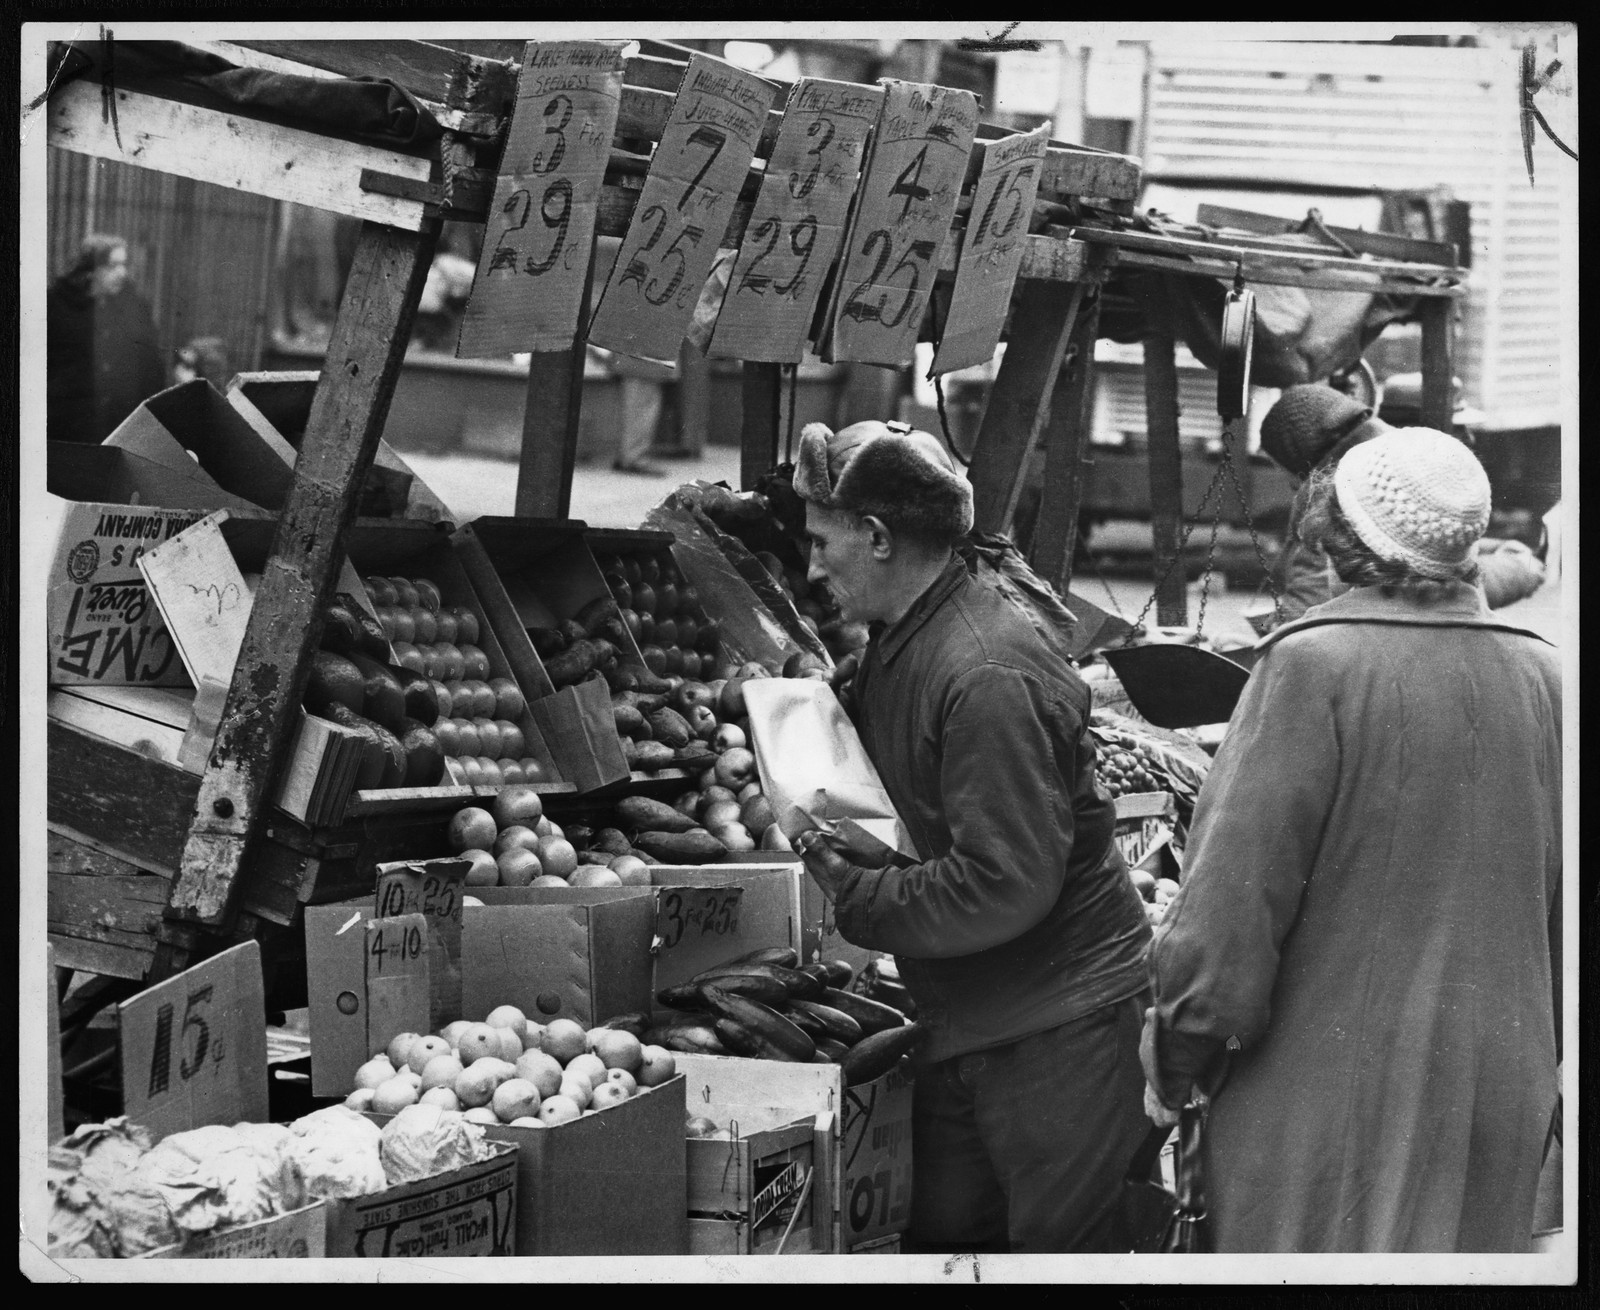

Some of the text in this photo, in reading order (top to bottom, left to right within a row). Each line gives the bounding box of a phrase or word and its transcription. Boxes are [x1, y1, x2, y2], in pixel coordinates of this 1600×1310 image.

[532, 94, 573, 176] 3
[788, 117, 836, 199] 3
[677, 125, 727, 211] 7
[888, 144, 930, 224] 4
[93, 513, 163, 540] COMPANY
[56, 625, 188, 683] CME
[380, 881, 405, 919] 10
[664, 893, 685, 949] 3
[371, 928, 388, 974] 4
[363, 1207, 392, 1227] STATE
[445, 1187, 461, 1202] THE
[426, 1228, 449, 1255] Fruit
